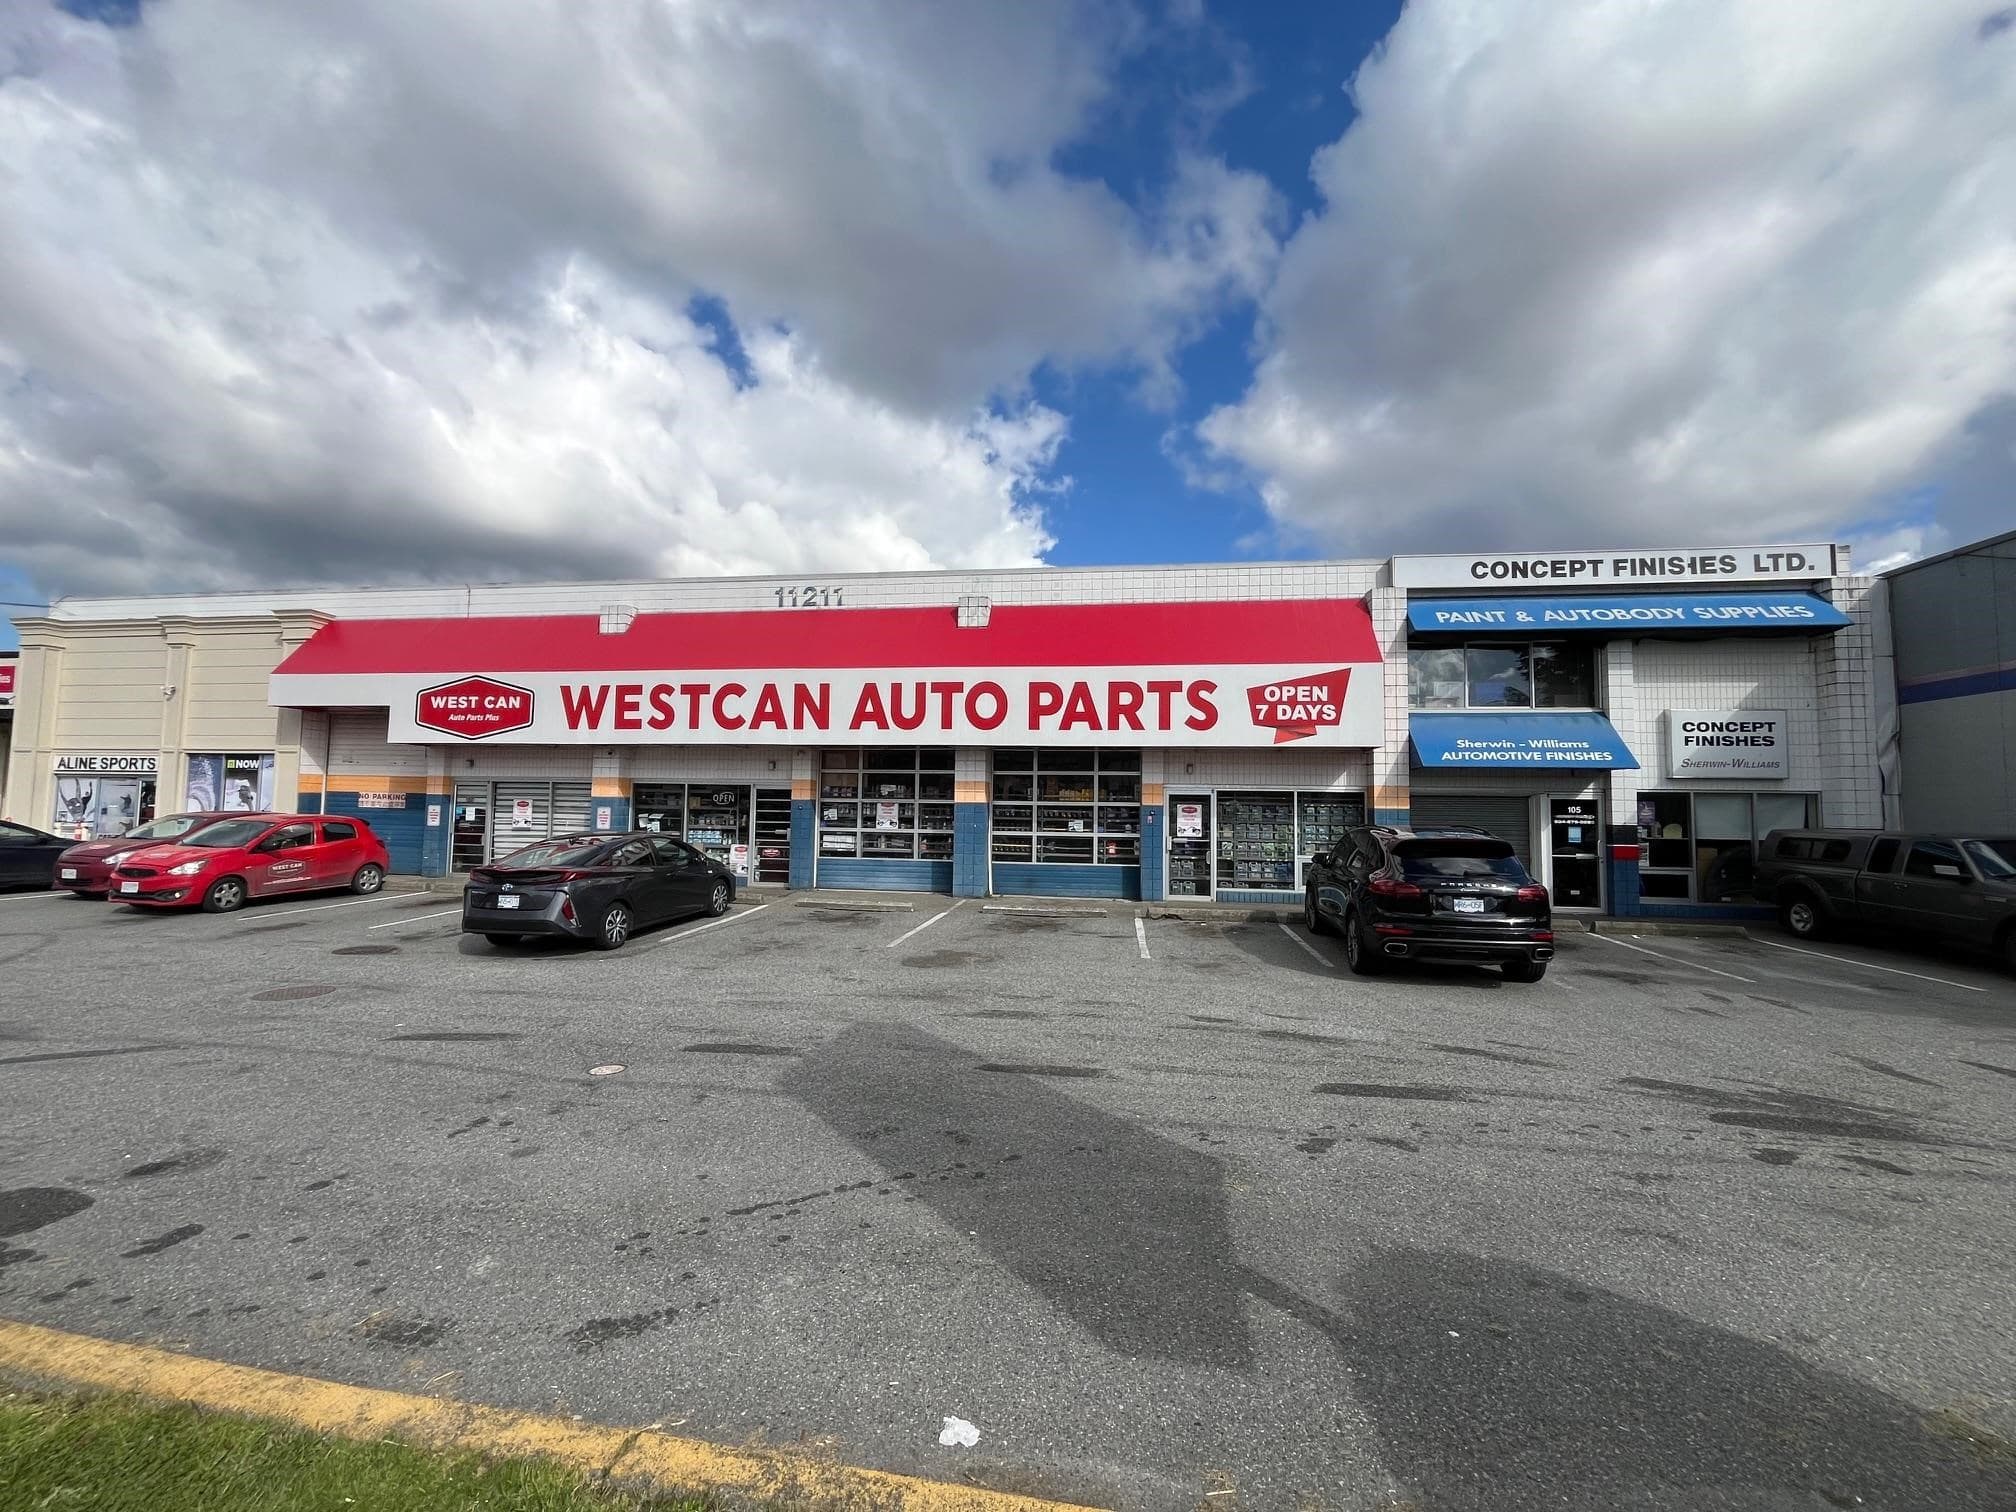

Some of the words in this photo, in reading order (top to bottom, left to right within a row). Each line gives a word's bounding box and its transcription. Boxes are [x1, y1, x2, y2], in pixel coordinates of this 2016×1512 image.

[1470, 559, 1604, 579] CONCEPT
[1753, 553, 1815, 573] LTD.
[775, 586, 843, 608] 11211
[1435, 611, 1505, 623] PAINT
[1516, 610, 1536, 622] &
[1544, 608, 1686, 622] AUTOBODY
[1693, 605, 1815, 619] SUPPLIES
[1264, 686, 1328, 702] OPEN
[431, 696, 479, 709] WEST
[484, 696, 521, 709] CAN
[560, 682, 830, 731] WESTCAN
[849, 681, 1008, 731] AUTO
[1028, 680, 1219, 732] PARTS
[448, 713, 466, 721] Auto
[466, 713, 484, 721] Parts
[485, 713, 500, 721] Plus
[1256, 704, 1269, 720] 7
[1276, 704, 1337, 721] DAYS
[1682, 722, 1776, 732] CONCEPT
[1456, 739, 1515, 748] Sherwin
[1528, 739, 1590, 748] Williams
[1684, 736, 1775, 746] FINISHES
[1441, 752, 1542, 761] AUTOMOTIVE
[1546, 752, 1612, 761] FINISHES
[57, 757, 97, 770] ALINE
[100, 757, 156, 770] SPORTS
[235, 759, 259, 769] NOW
[372, 793, 407, 801] PARKING
[713, 794, 735, 802] OPEN
[1567, 806, 1582, 814] 105
